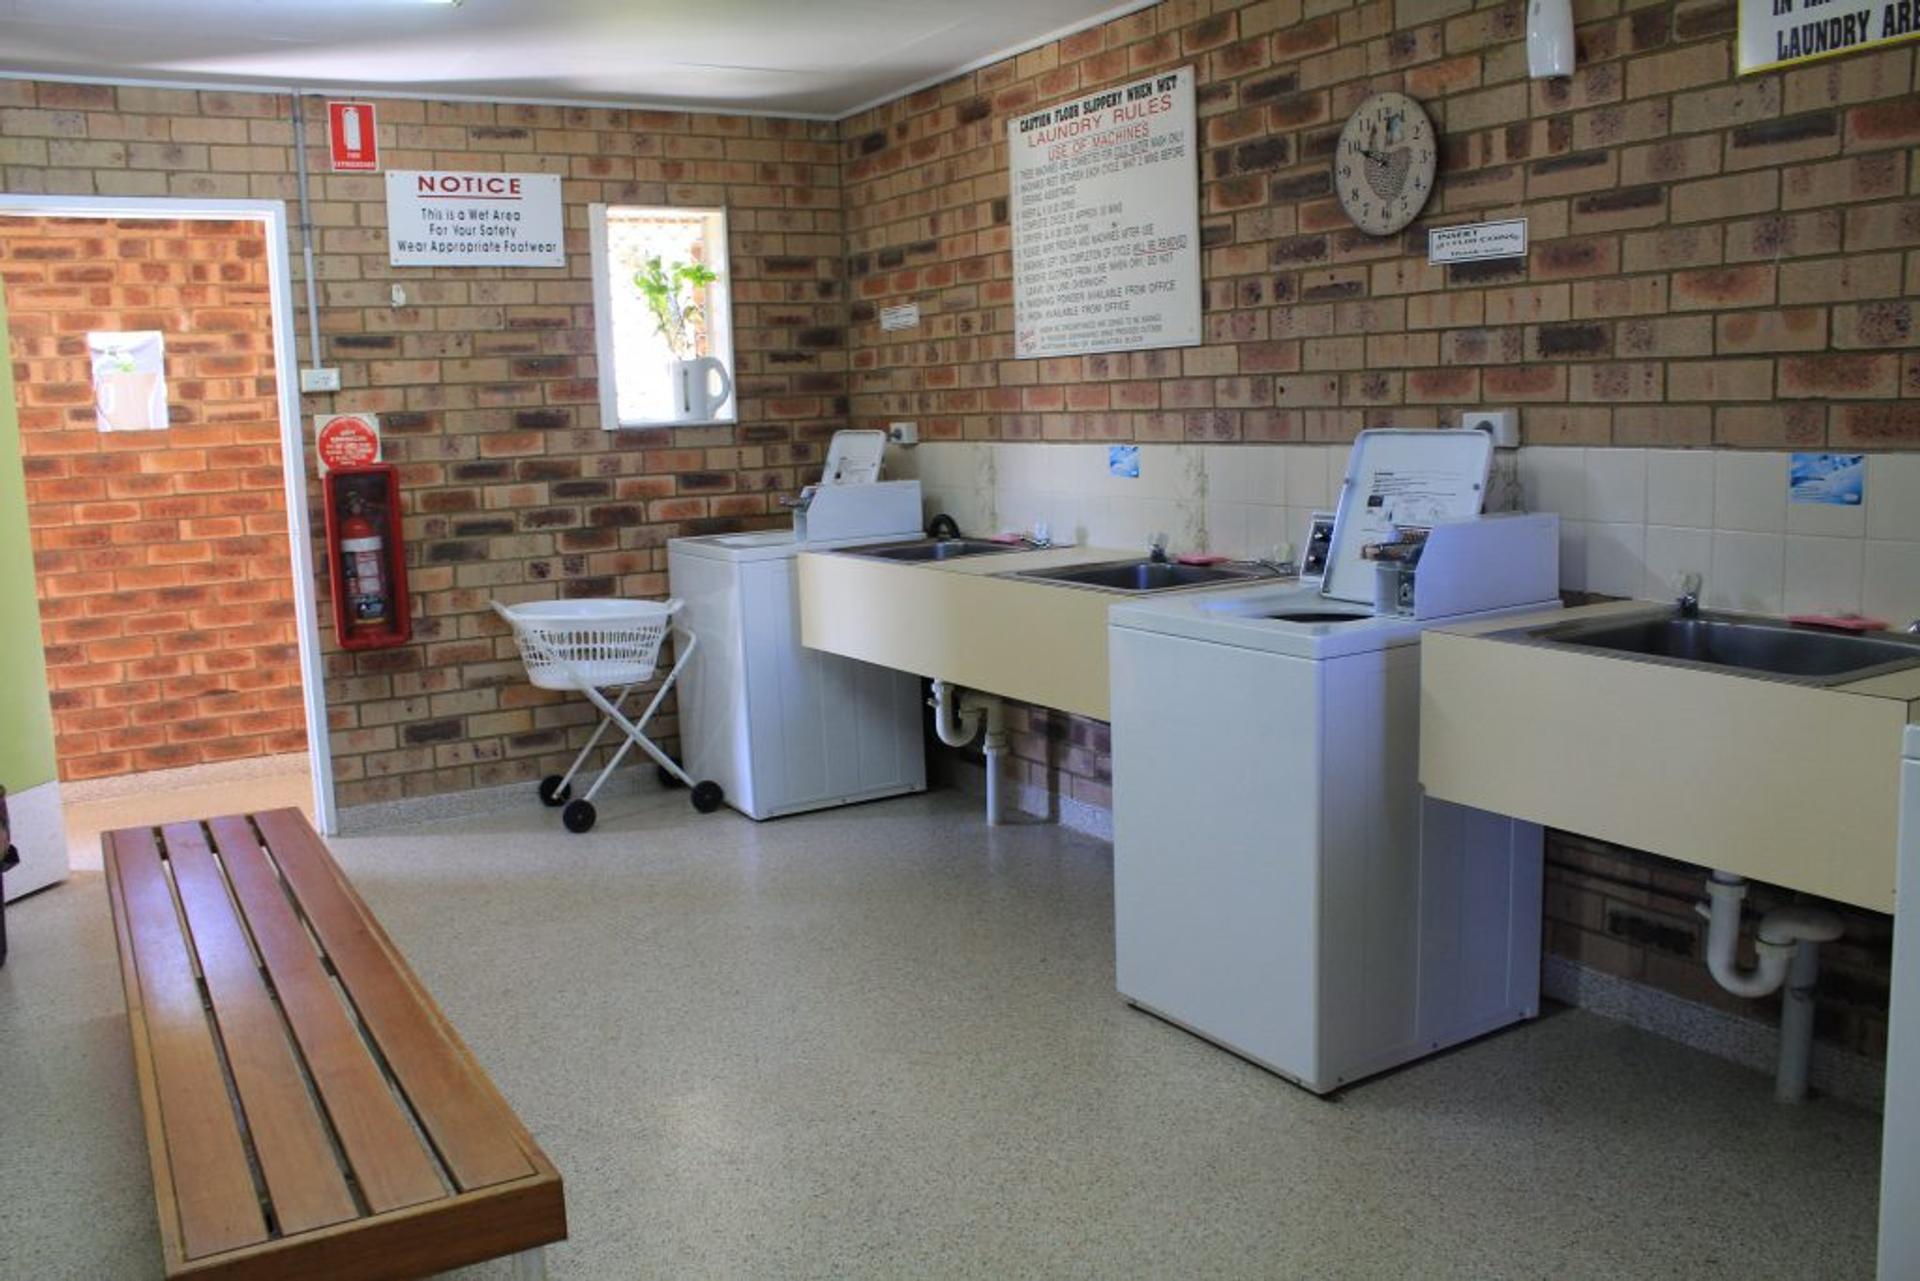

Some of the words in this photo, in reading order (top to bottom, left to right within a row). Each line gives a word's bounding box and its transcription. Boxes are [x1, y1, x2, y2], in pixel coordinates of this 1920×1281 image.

[1777, 9, 1871, 61] LAUNDRY
[1020, 113, 1051, 133] CAUTION
[1055, 105, 1079, 123] FLOOR
[1083, 91, 1122, 114] SLIPPERY
[1126, 82, 1152, 101] WHEN
[1157, 75, 1177, 93] WET
[1028, 115, 1102, 148] LAUNDRY
[1113, 95, 1172, 124] RULES
[1048, 143, 1067, 161] USE
[1094, 123, 1148, 147] MACHINES
[418, 175, 521, 194] NOTICE
[1351, 188, 1359, 202] 8
[421, 208, 442, 221] This
[446, 209, 456, 221] is
[458, 212, 465, 221] a
[469, 208, 490, 221] Wet
[493, 209, 520, 221] Area
[429, 224, 449, 236] For
[453, 225, 476, 237] Your
[480, 224, 517, 239] Safety
[397, 240, 428, 253] Wear
[431, 240, 501, 257] Appropriate
[504, 240, 557, 253] Footwear
[1087, 286, 1122, 301] AVAILABLE
[1124, 283, 1145, 296] FROM
[1148, 279, 1176, 293] OFFICE
[1080, 303, 1101, 315] FROM
[1104, 300, 1130, 312] OFFICE
